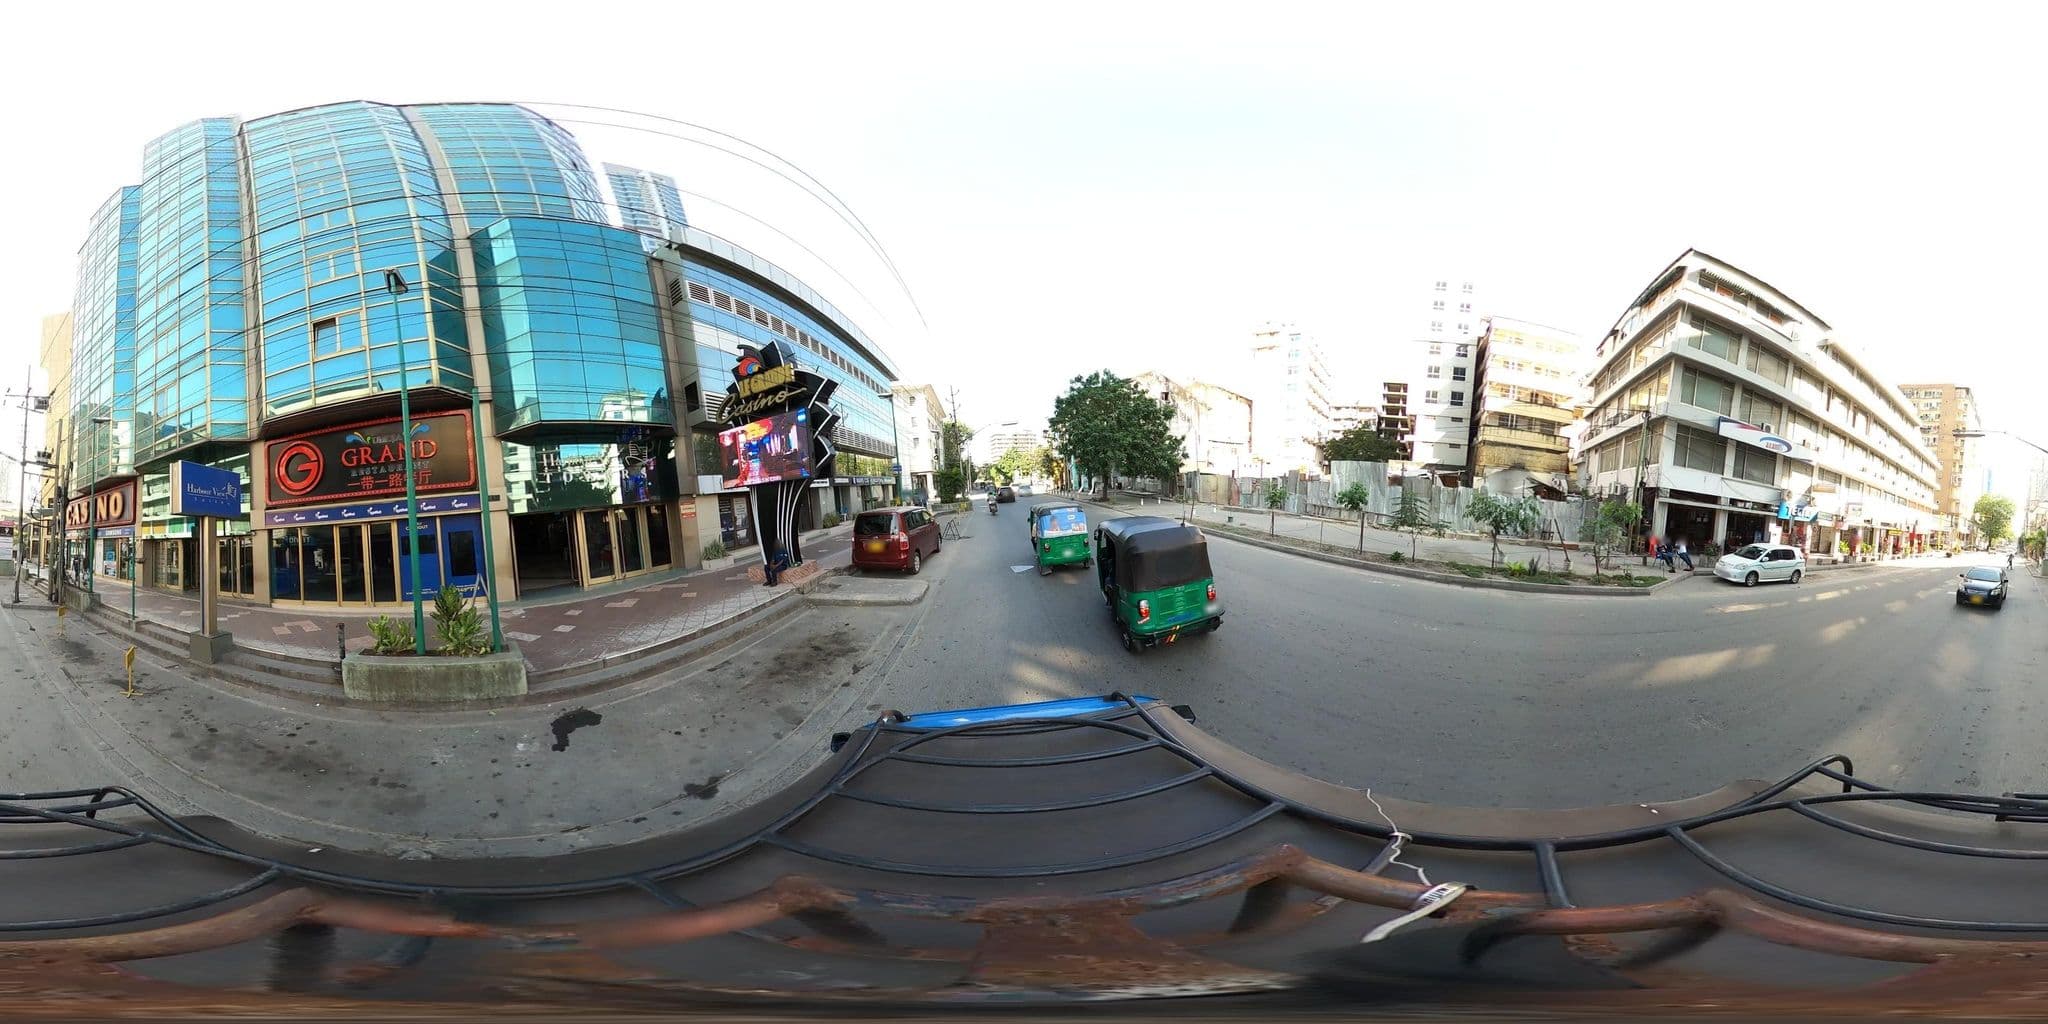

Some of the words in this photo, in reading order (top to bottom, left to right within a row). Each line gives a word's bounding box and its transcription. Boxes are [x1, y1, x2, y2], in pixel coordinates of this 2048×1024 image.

[716, 387, 808, 425] Casino
[341, 439, 438, 468] GRAND
[66, 491, 124, 525] CASNO
